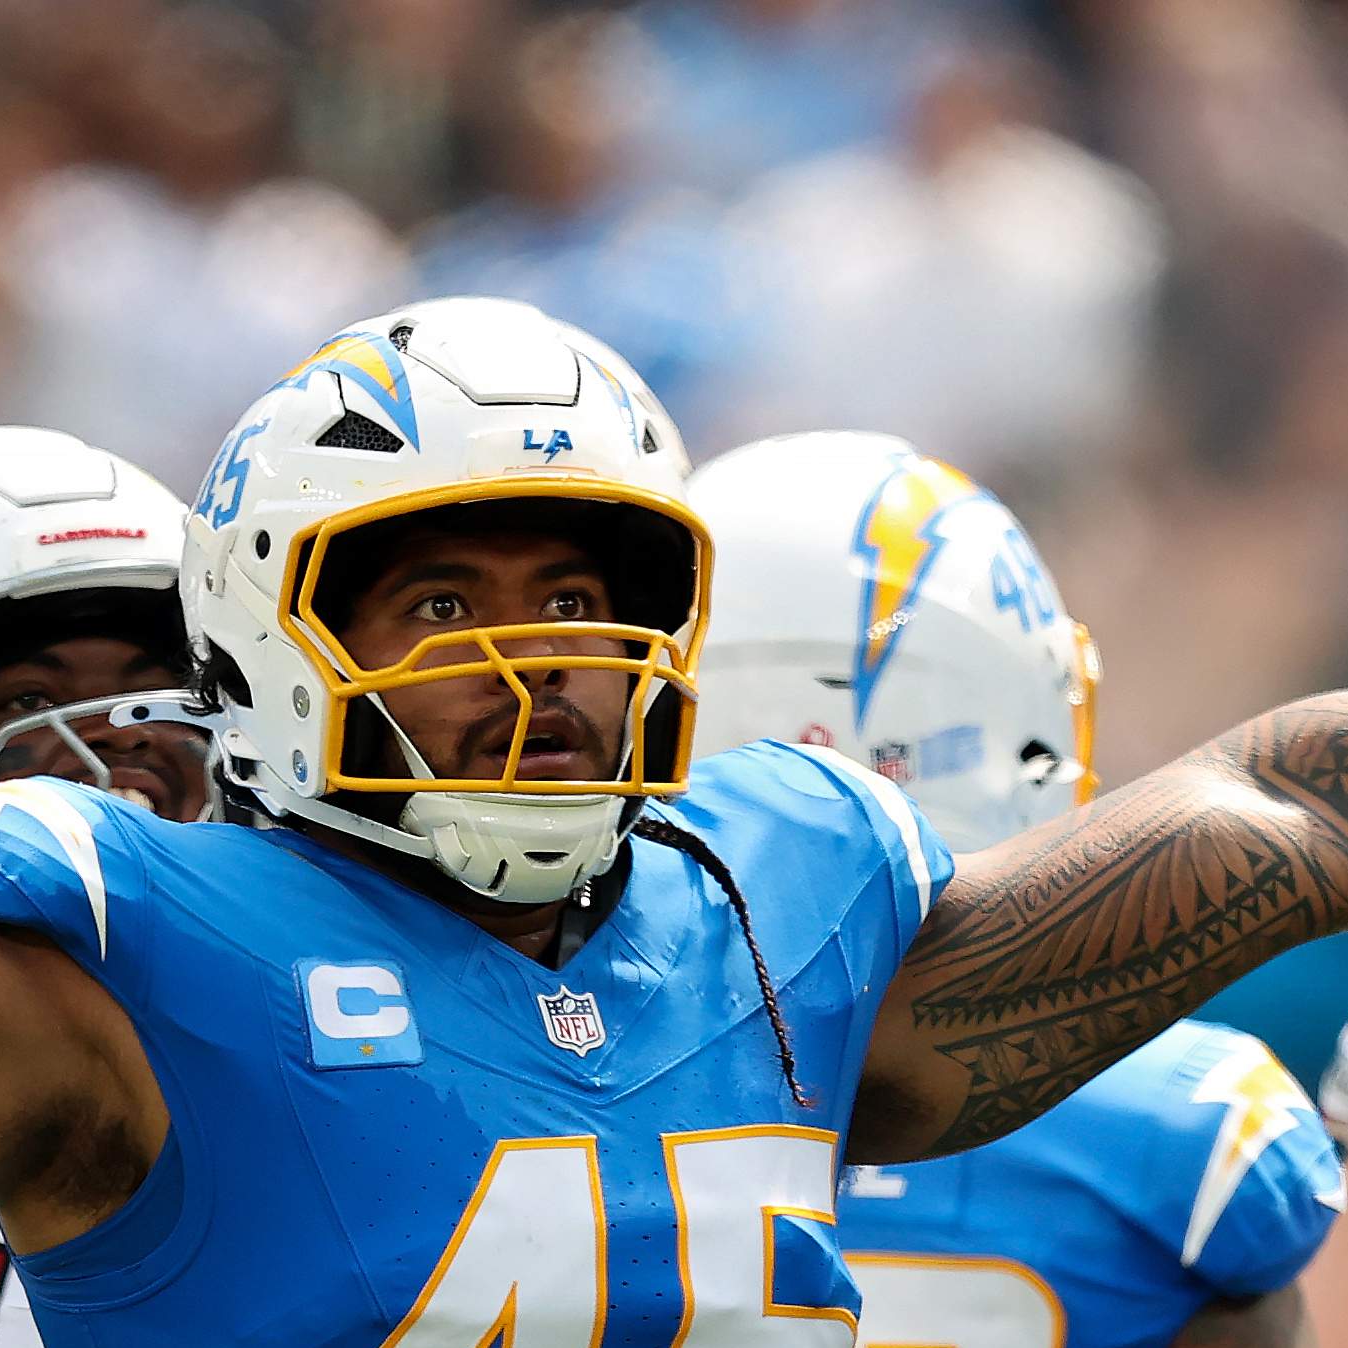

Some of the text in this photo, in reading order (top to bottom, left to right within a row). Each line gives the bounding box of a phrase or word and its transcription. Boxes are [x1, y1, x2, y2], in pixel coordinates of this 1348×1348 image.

[522, 429, 573, 464] LA
[307, 964, 411, 1039] C
[554, 1016, 596, 1042] NFL
